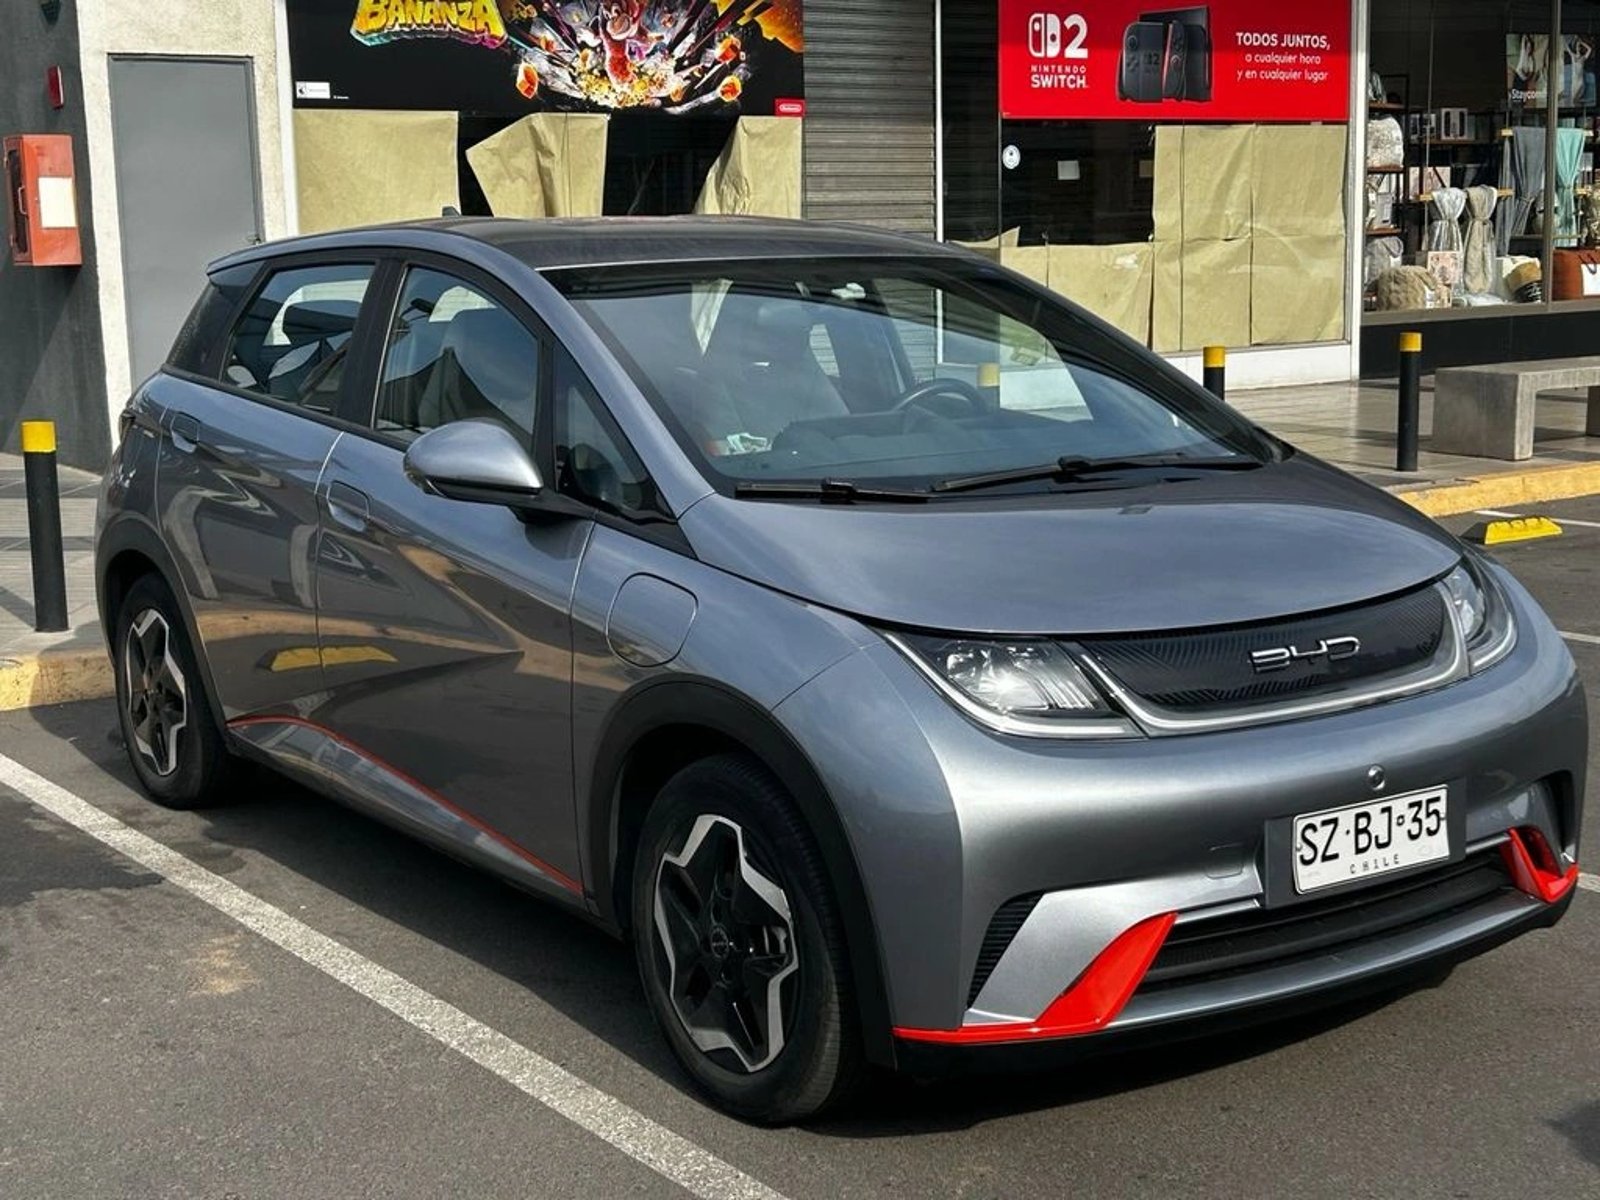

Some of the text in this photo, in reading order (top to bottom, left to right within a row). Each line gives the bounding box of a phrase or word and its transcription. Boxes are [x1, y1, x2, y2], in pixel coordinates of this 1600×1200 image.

[352, 0, 508, 46] BANANZA
[1236, 32, 1331, 51] TODOS JUNTOS,
[1245, 52, 1321, 66] a cualquier hora
[1030, 64, 1087, 74] NINTENDO
[1237, 68, 1329, 84] y en cualquier lugar
[1030, 74, 1087, 89] SWITCH
[1250, 636, 1360, 672] BYD
[1349, 853, 1400, 875] CHILE
